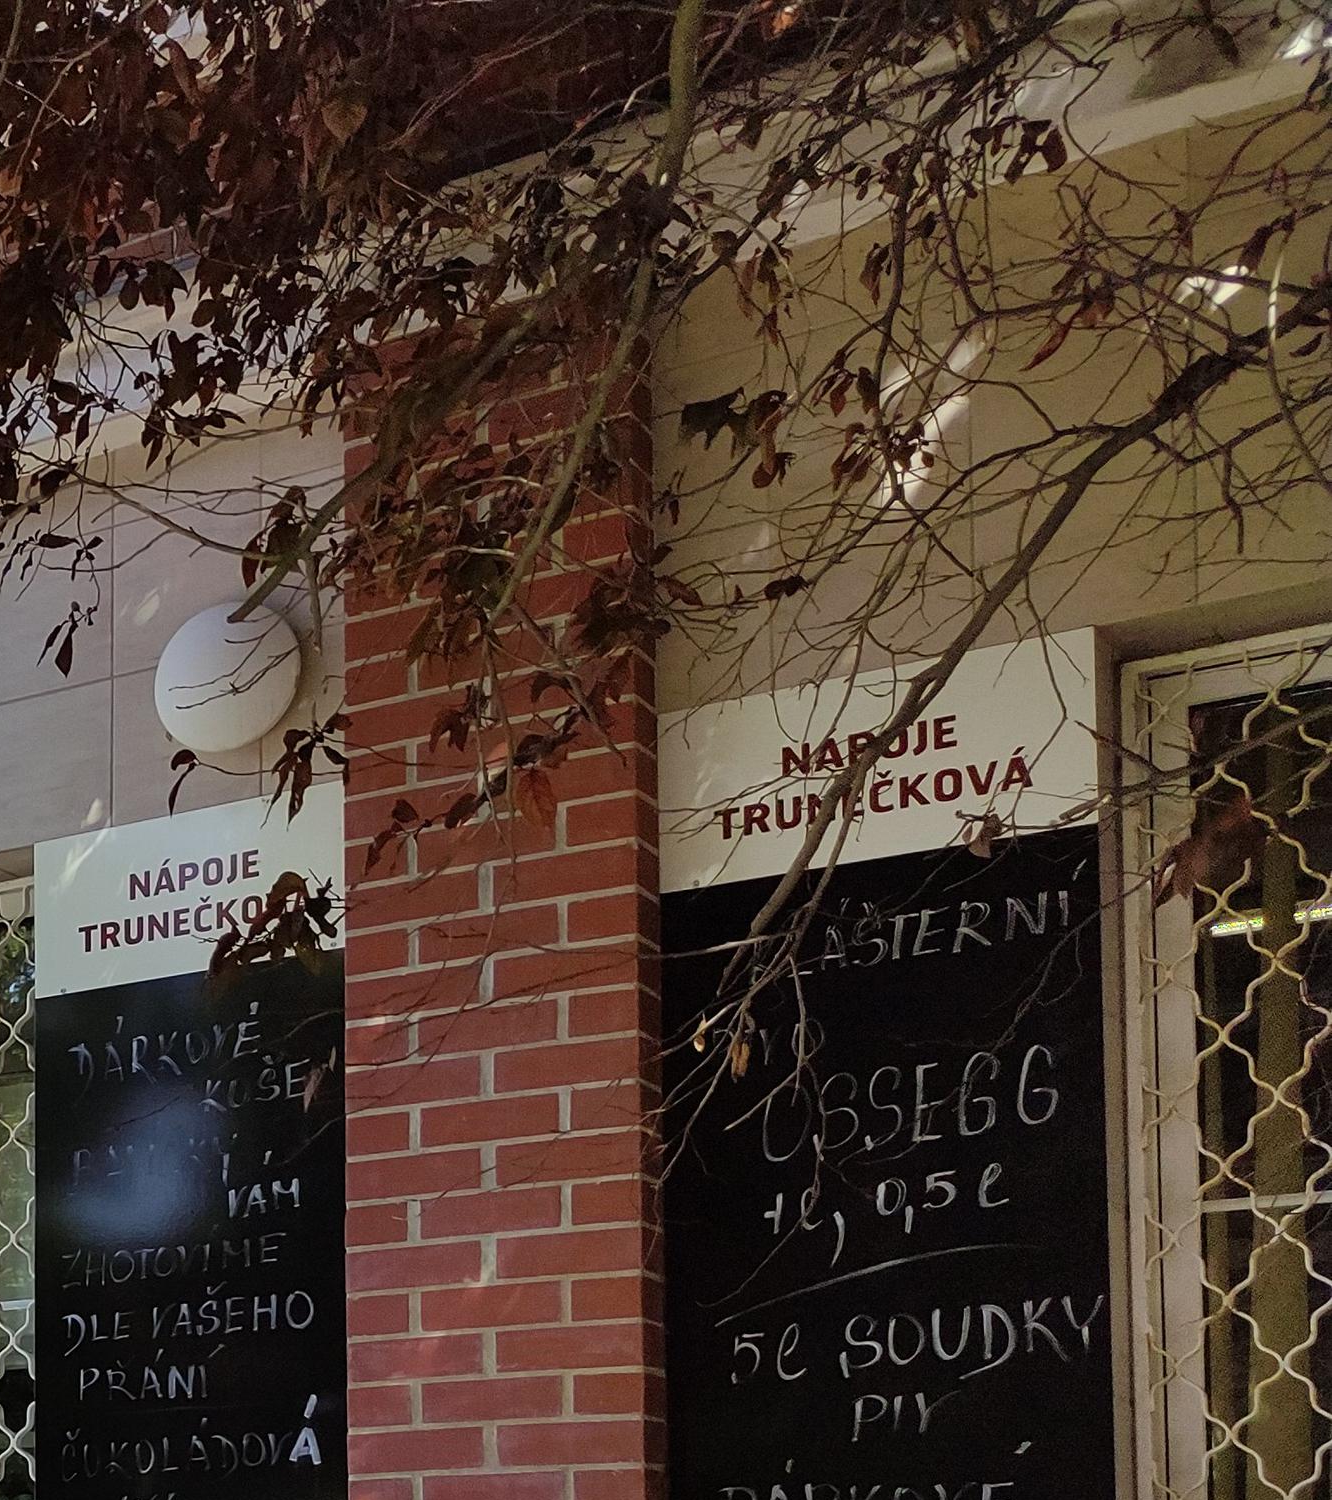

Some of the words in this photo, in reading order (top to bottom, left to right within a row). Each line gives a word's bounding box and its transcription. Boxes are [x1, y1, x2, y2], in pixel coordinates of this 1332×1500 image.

[129, 849, 261, 900] NÁPOJE
[748, 858, 1089, 990] ÁŠTERNÍ
[68, 1001, 262, 1093] DÁRKOVÉ
[713, 1018, 825, 1065] VO
[762, 1044, 1059, 1162] OSSEGG
[226, 1149, 301, 1219] VÁM
[63, 1312, 134, 1357] DLE
[152, 1281, 315, 1340] VAŠEHO
[840, 1294, 1105, 1380] SOUDKY
[79, 1344, 225, 1400] PŘÁNÍ
[851, 1390, 963, 1442] PIV
